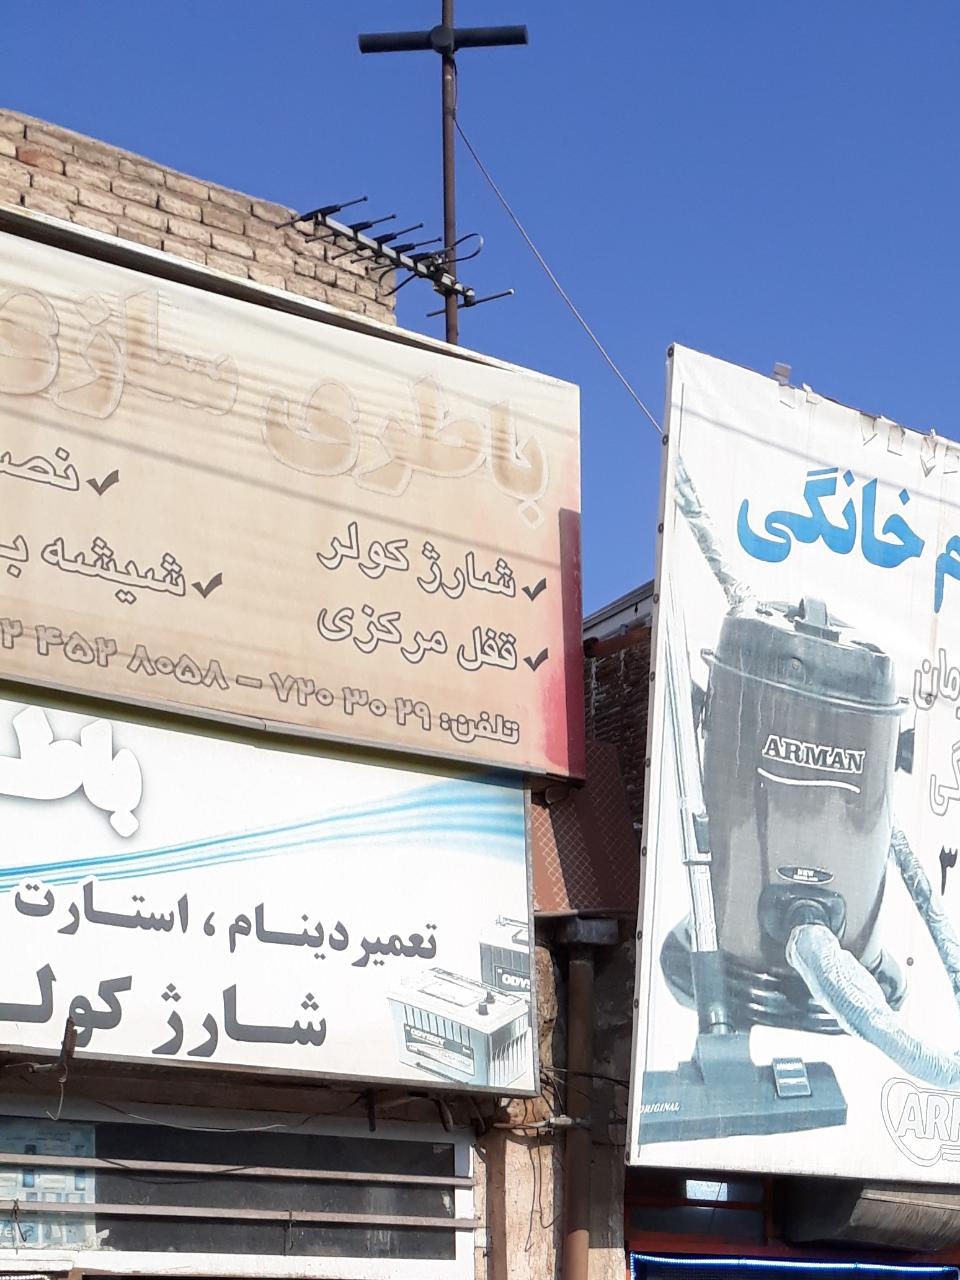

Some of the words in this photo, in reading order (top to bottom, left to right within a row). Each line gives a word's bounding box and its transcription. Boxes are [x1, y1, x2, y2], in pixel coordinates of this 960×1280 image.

[737, 467, 925, 569] خانگی
[41, 536, 186, 605] شیشه
[316, 521, 410, 579] کولر
[418, 542, 516, 599] شارژ
[316, 604, 449, 663] مرکزی
[457, 626, 518, 671] قفل
[762, 735, 866, 774] ARMAN
[15, 880, 189, 936] استارت
[229, 902, 350, 960] دینام
[351, 923, 437, 967] تعمیر
[152, 983, 327, 1057] شارژ
